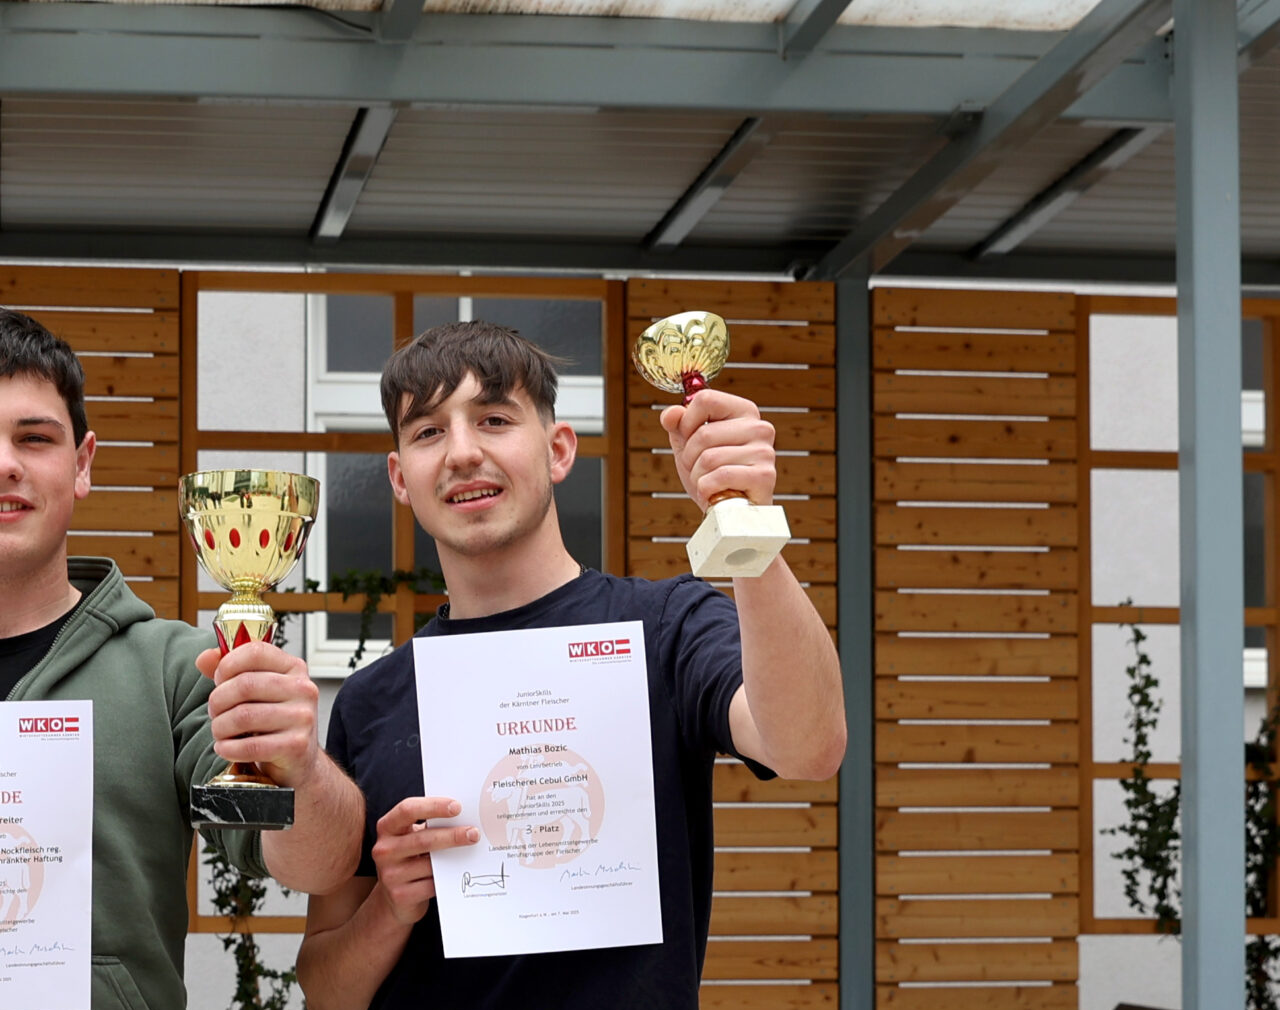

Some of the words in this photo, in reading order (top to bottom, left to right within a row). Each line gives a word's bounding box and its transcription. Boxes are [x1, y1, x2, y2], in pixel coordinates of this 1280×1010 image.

[568, 640, 614, 658] WKO
[516, 690, 552, 698] JuniorSkills
[499, 701, 510, 709] der
[512, 699, 539, 708] Kärntner
[541, 697, 570, 706] Fleischer
[19, 717, 63, 733] WKO
[496, 717, 577, 736] URKUNDE
[509, 746, 542, 756] Mathias
[493, 778, 537, 789] Fleischerei
[564, 774, 588, 784] GmbH
[539, 825, 561, 833] Platz
[1, 846, 45, 855] Nockfleisch
[33, 854, 63, 865] Haftung
